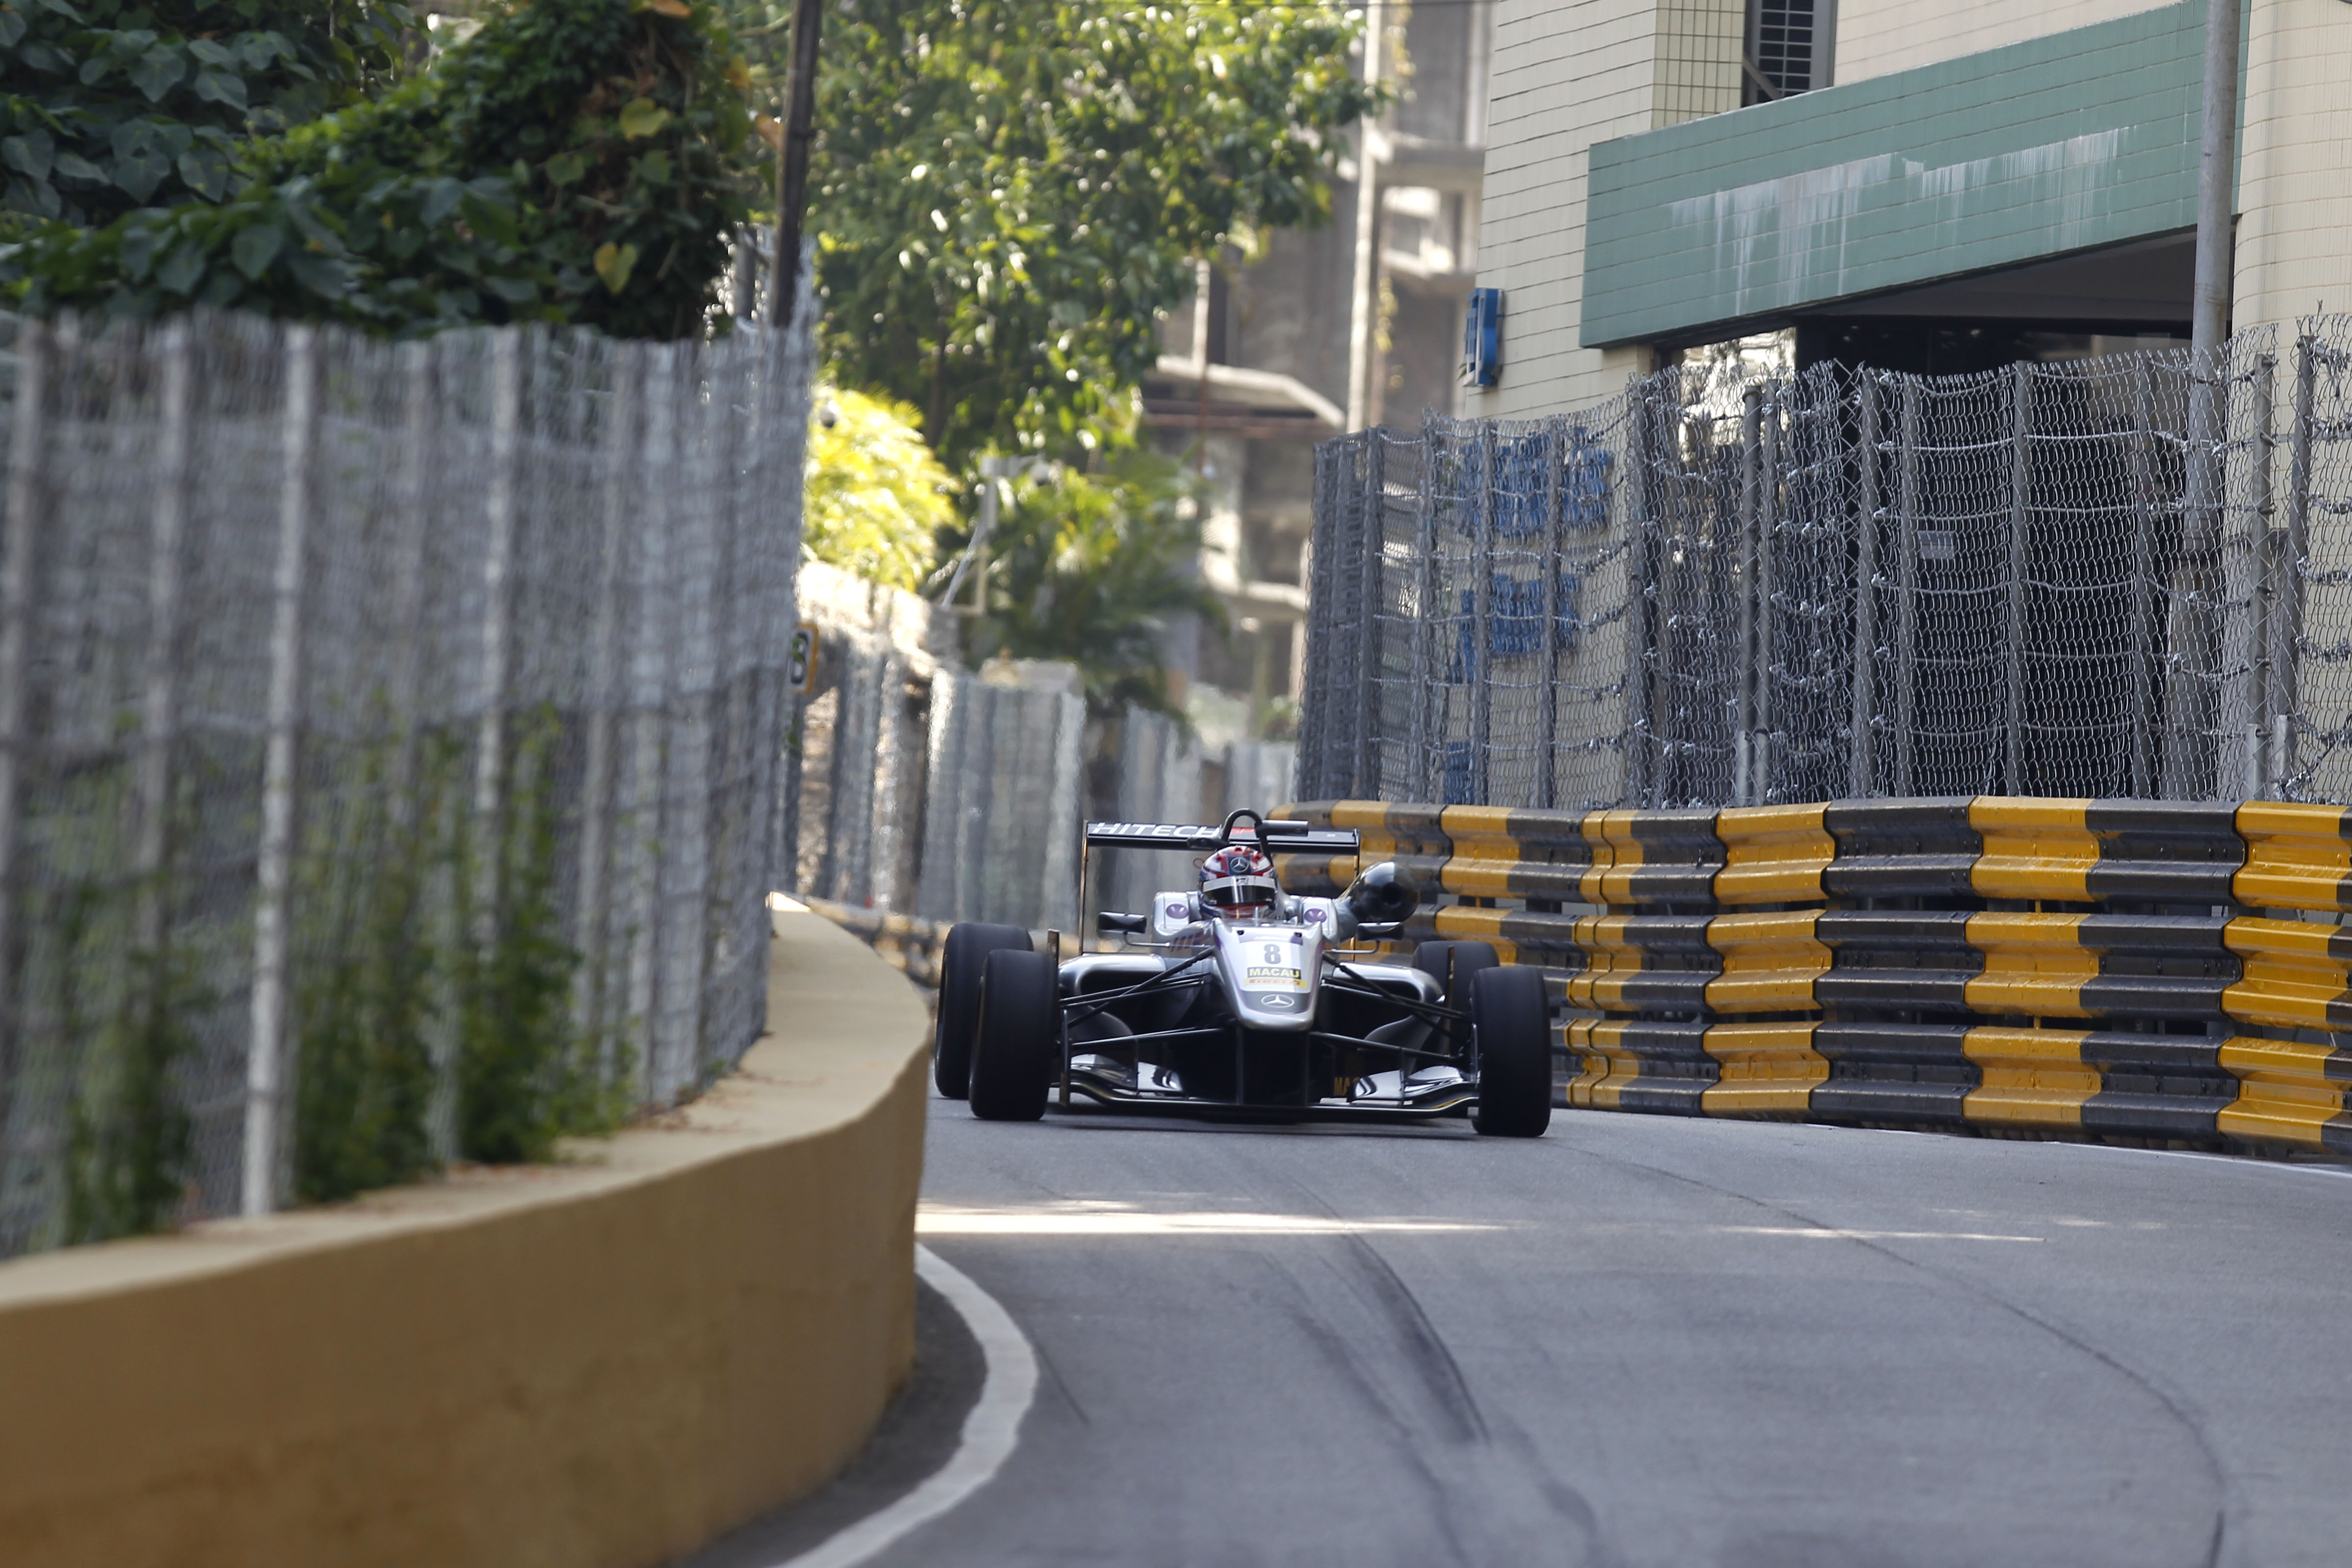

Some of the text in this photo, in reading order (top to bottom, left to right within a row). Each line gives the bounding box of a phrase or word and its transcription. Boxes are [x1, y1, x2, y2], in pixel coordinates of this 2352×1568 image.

[1092, 822, 1220, 837] HITECH
[1264, 944, 1281, 964] 8
[1250, 968, 1300, 978] MACAU
